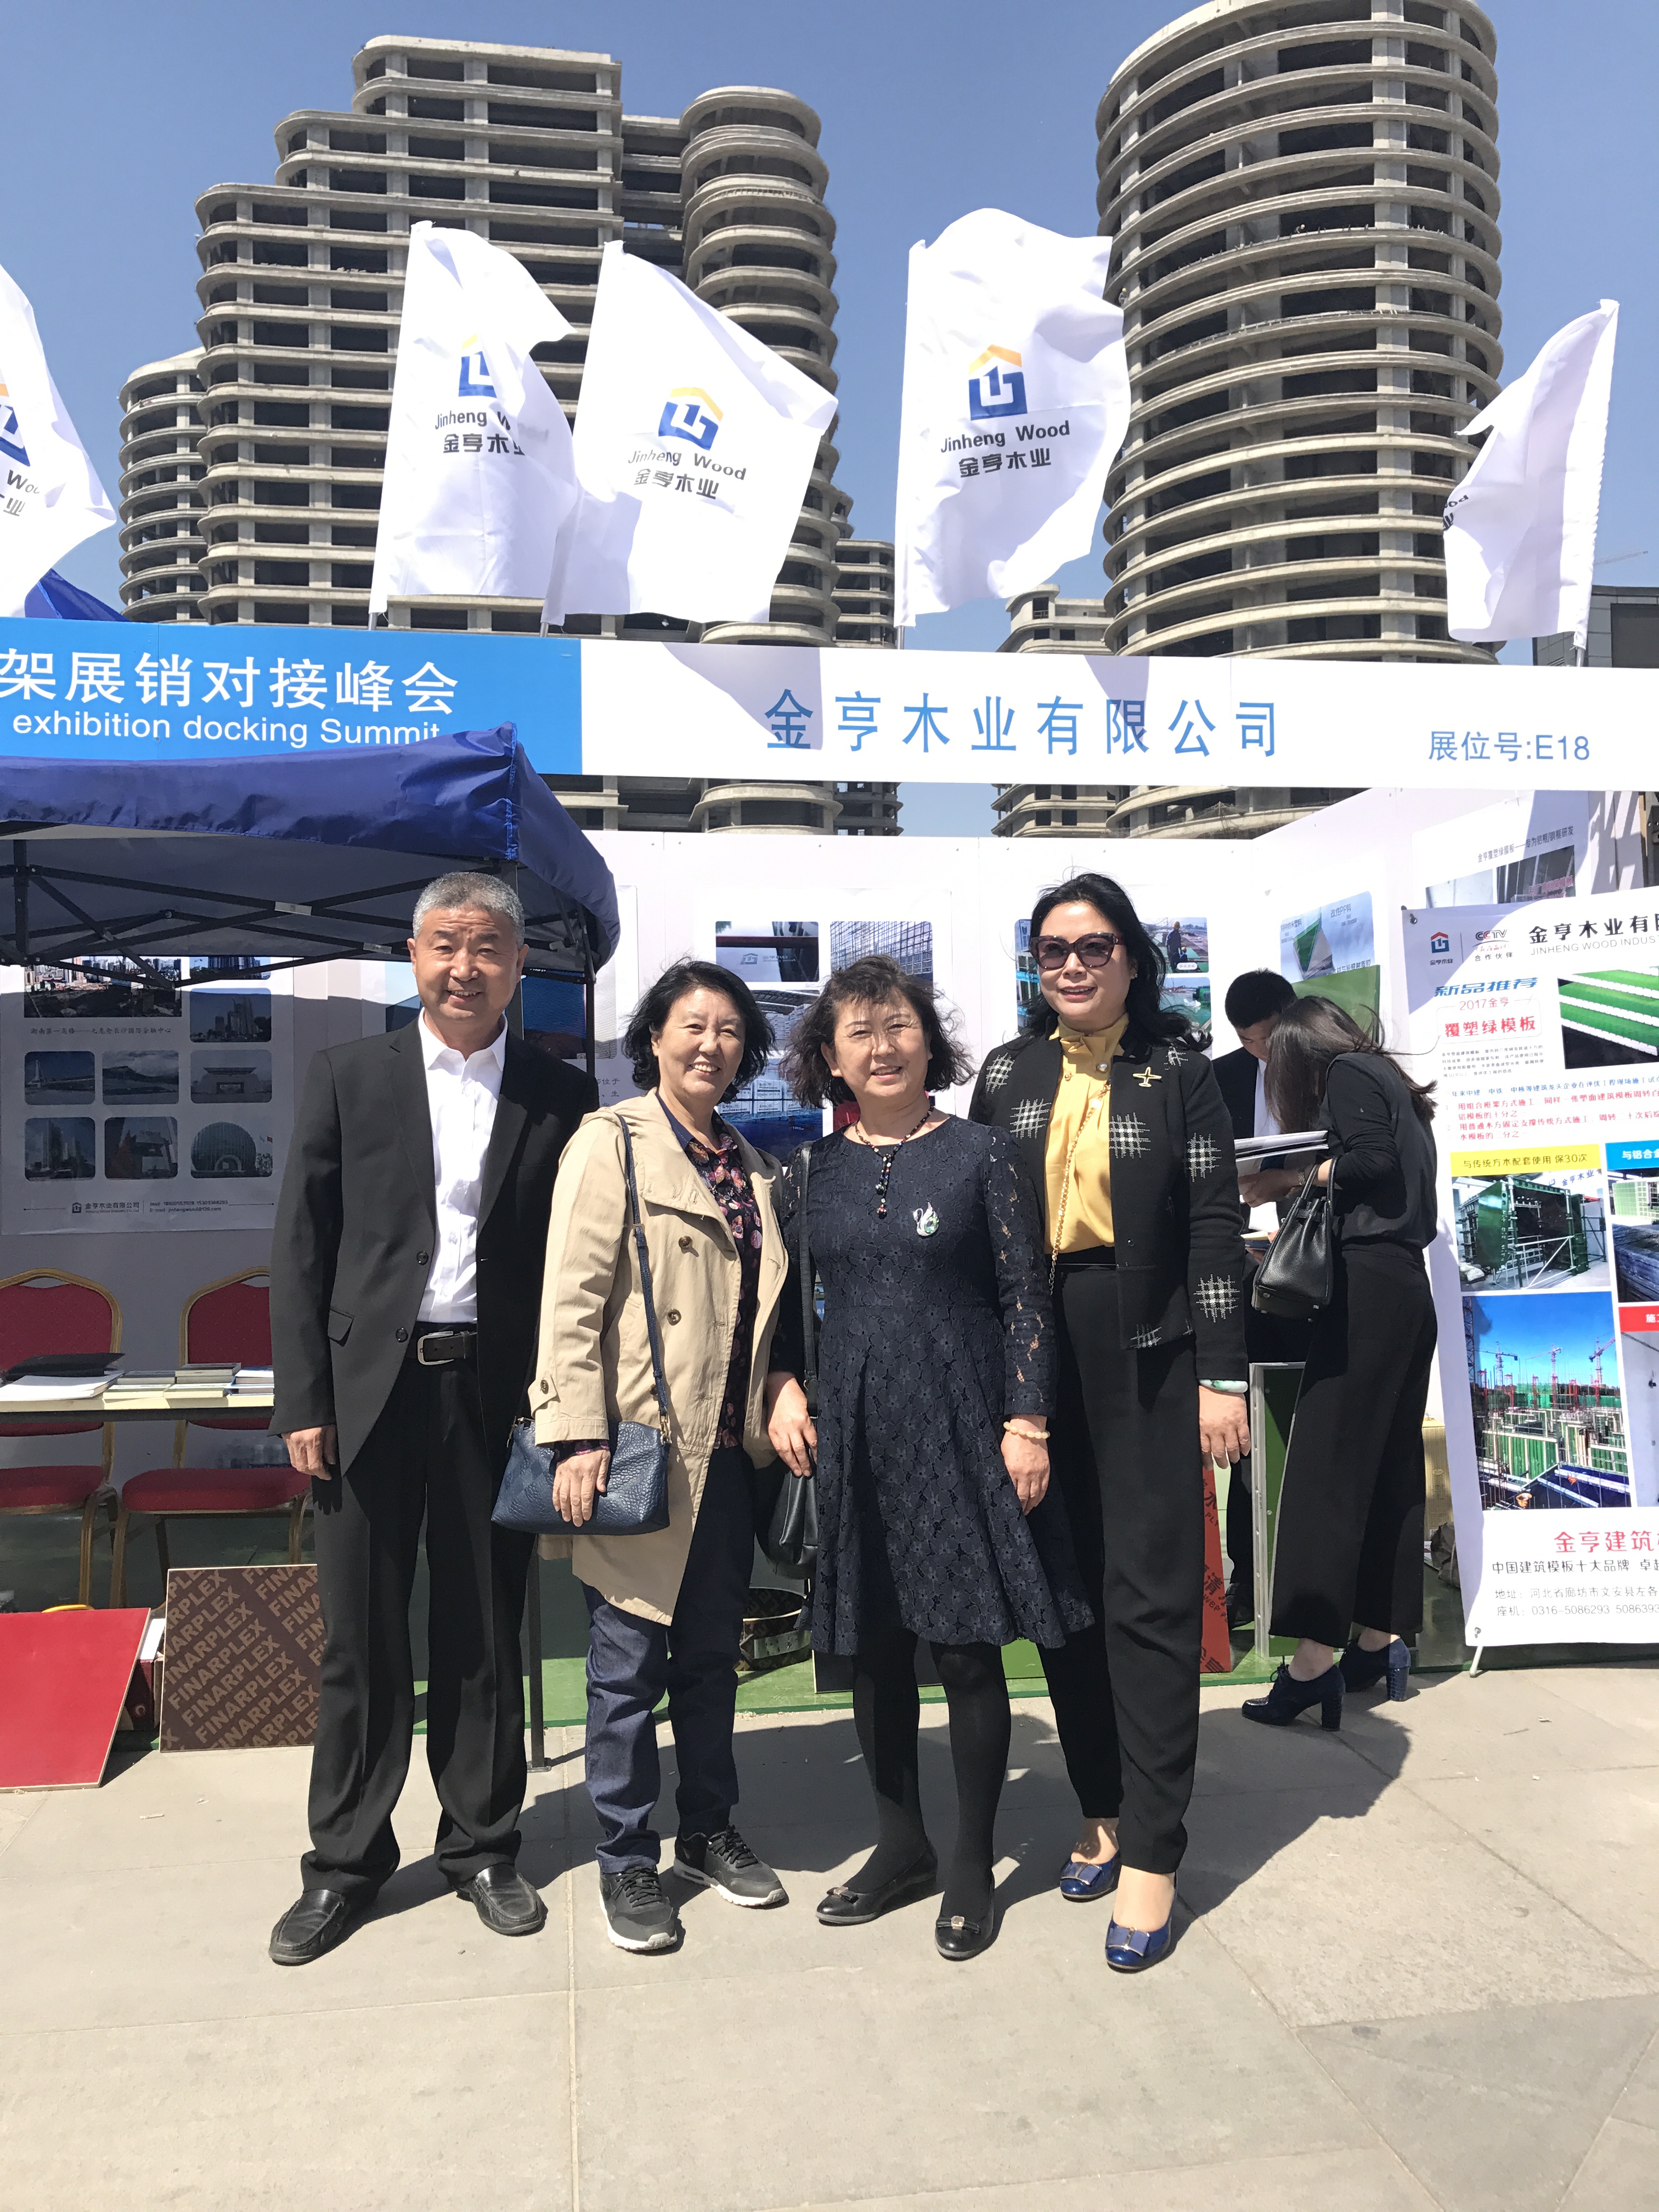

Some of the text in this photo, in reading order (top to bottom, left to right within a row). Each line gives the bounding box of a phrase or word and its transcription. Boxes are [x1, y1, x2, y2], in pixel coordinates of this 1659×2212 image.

[435, 410, 487, 430] Jinheng
[941, 420, 1070, 453] Jinheng Wood
[628, 449, 747, 481] Jinheng Wood
[958, 447, 1051, 478] 金亨木业
[634, 469, 719, 500] 金亨木业
[0, 648, 458, 715] 架展销对接峰会
[13, 710, 440, 748] exhibition docking Summit
[765, 688, 1274, 757] 金亨木业有限公司
[1428, 731, 1590, 762] 展位号:E18
[1475, 929, 1508, 941] CCTV
[1531, 943, 1579, 956] JINHENG
[1582, 939, 1617, 950] WOOD
[1475, 951, 1513, 961] 合作伙伴
[1434, 977, 1538, 997] 新品推荐
[1459, 997, 1509, 1011] 2017金亨
[1444, 1015, 1536, 1037] 覆塑绿模板
[1463, 1153, 1588, 1169] 与传统方木配套使用 保30次
[1646, 1314, 1659, 1323] 施
[1554, 1530, 1659, 1553] 金亨建筑
[1492, 1559, 1629, 1575] 中国建筑模板十大品牌
[168, 1618, 267, 1711] FINARPLEX
[182, 1634, 280, 1727] FINARPLEX
[195, 1651, 294, 1744] FINARPLEX
